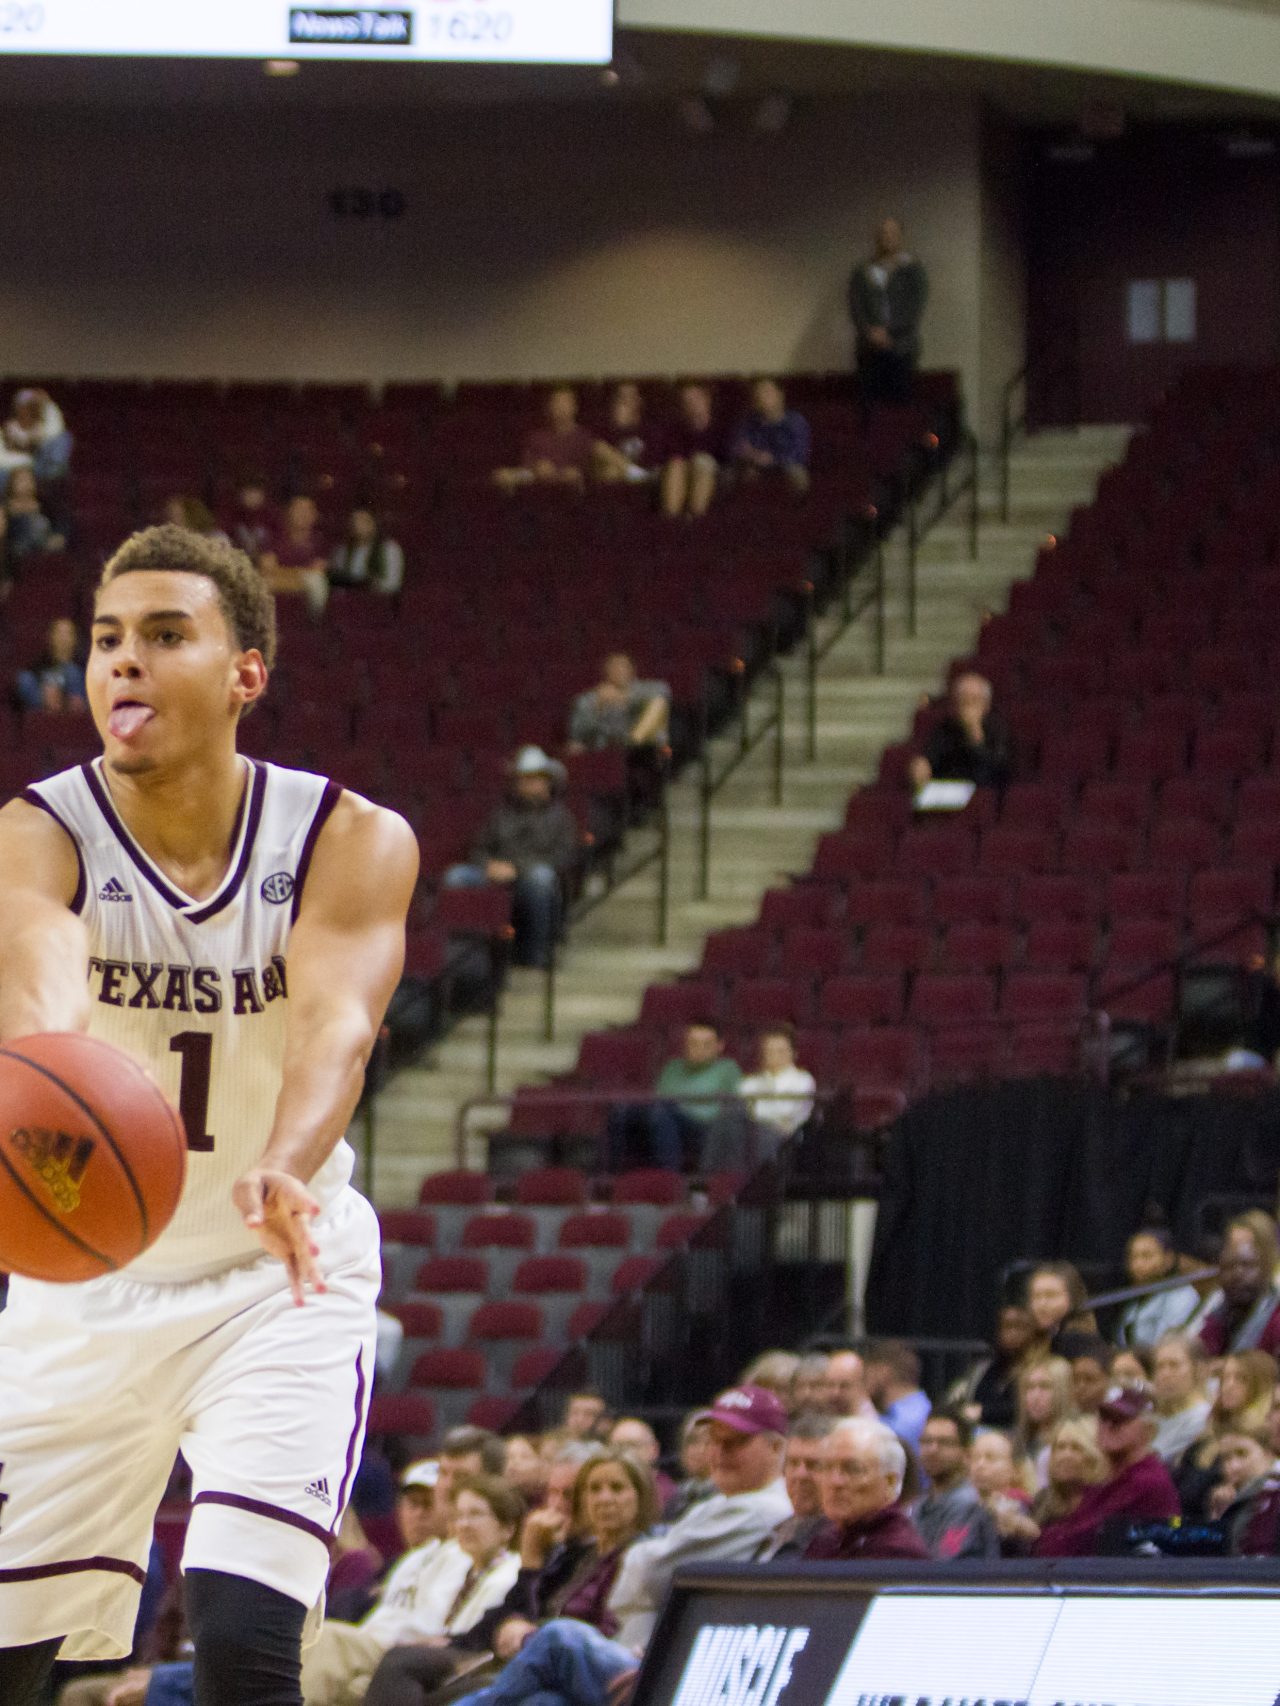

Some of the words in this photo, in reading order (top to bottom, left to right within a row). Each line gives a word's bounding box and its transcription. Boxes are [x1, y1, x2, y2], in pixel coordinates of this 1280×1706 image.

[291, 10, 408, 41] NewsTalk
[429, 11, 514, 40] 1620
[169, 1030, 215, 1152] 1
